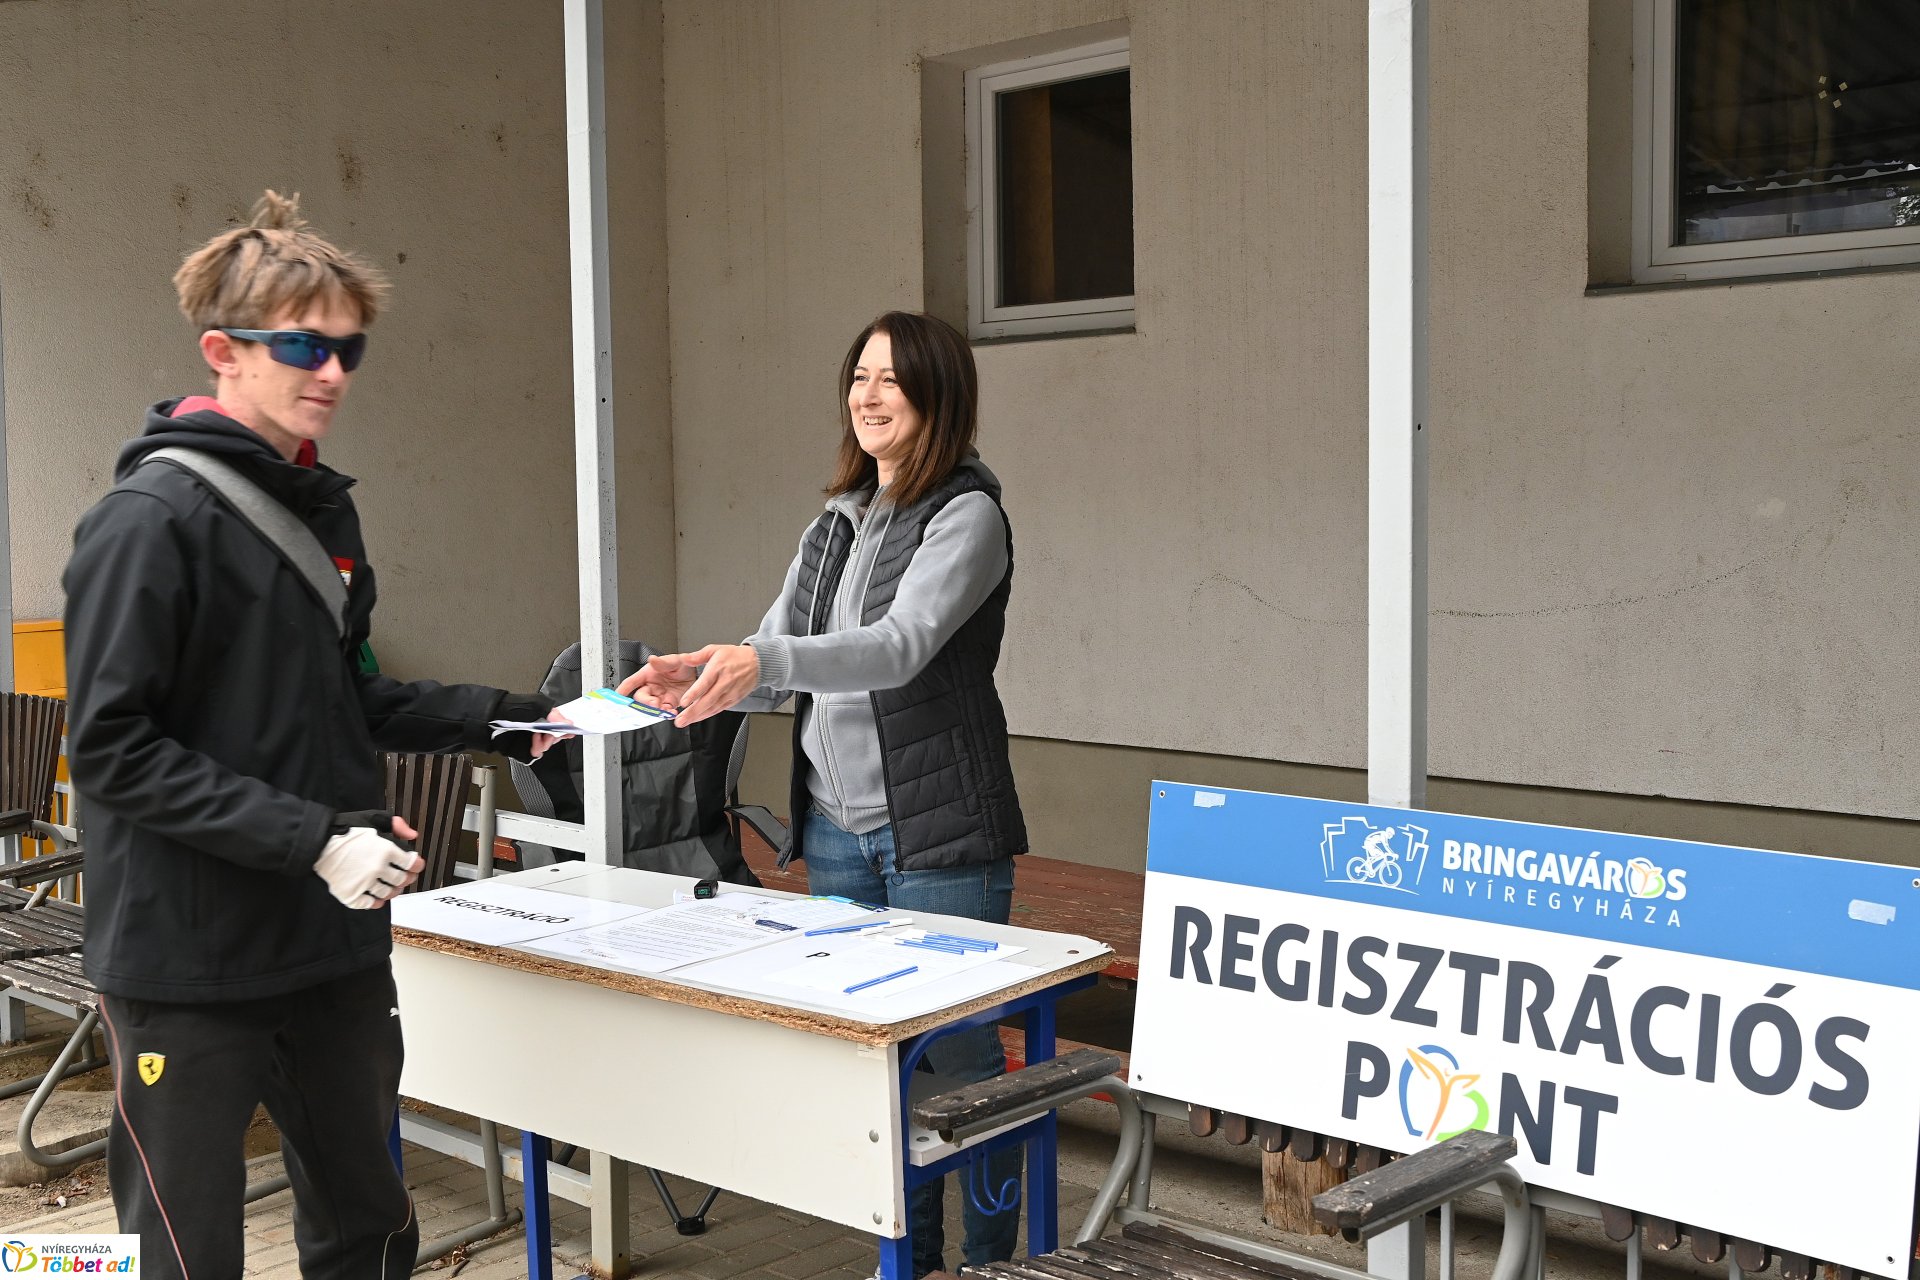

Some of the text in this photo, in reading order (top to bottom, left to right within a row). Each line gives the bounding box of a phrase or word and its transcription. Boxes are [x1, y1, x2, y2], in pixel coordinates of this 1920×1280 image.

[1441, 876, 1681, 928] NYÍREGYHÁZA
[1442, 839, 1687, 902] BRINGAVÁROS
[1169, 905, 1871, 1111] REGISZTRÁCIÓS
